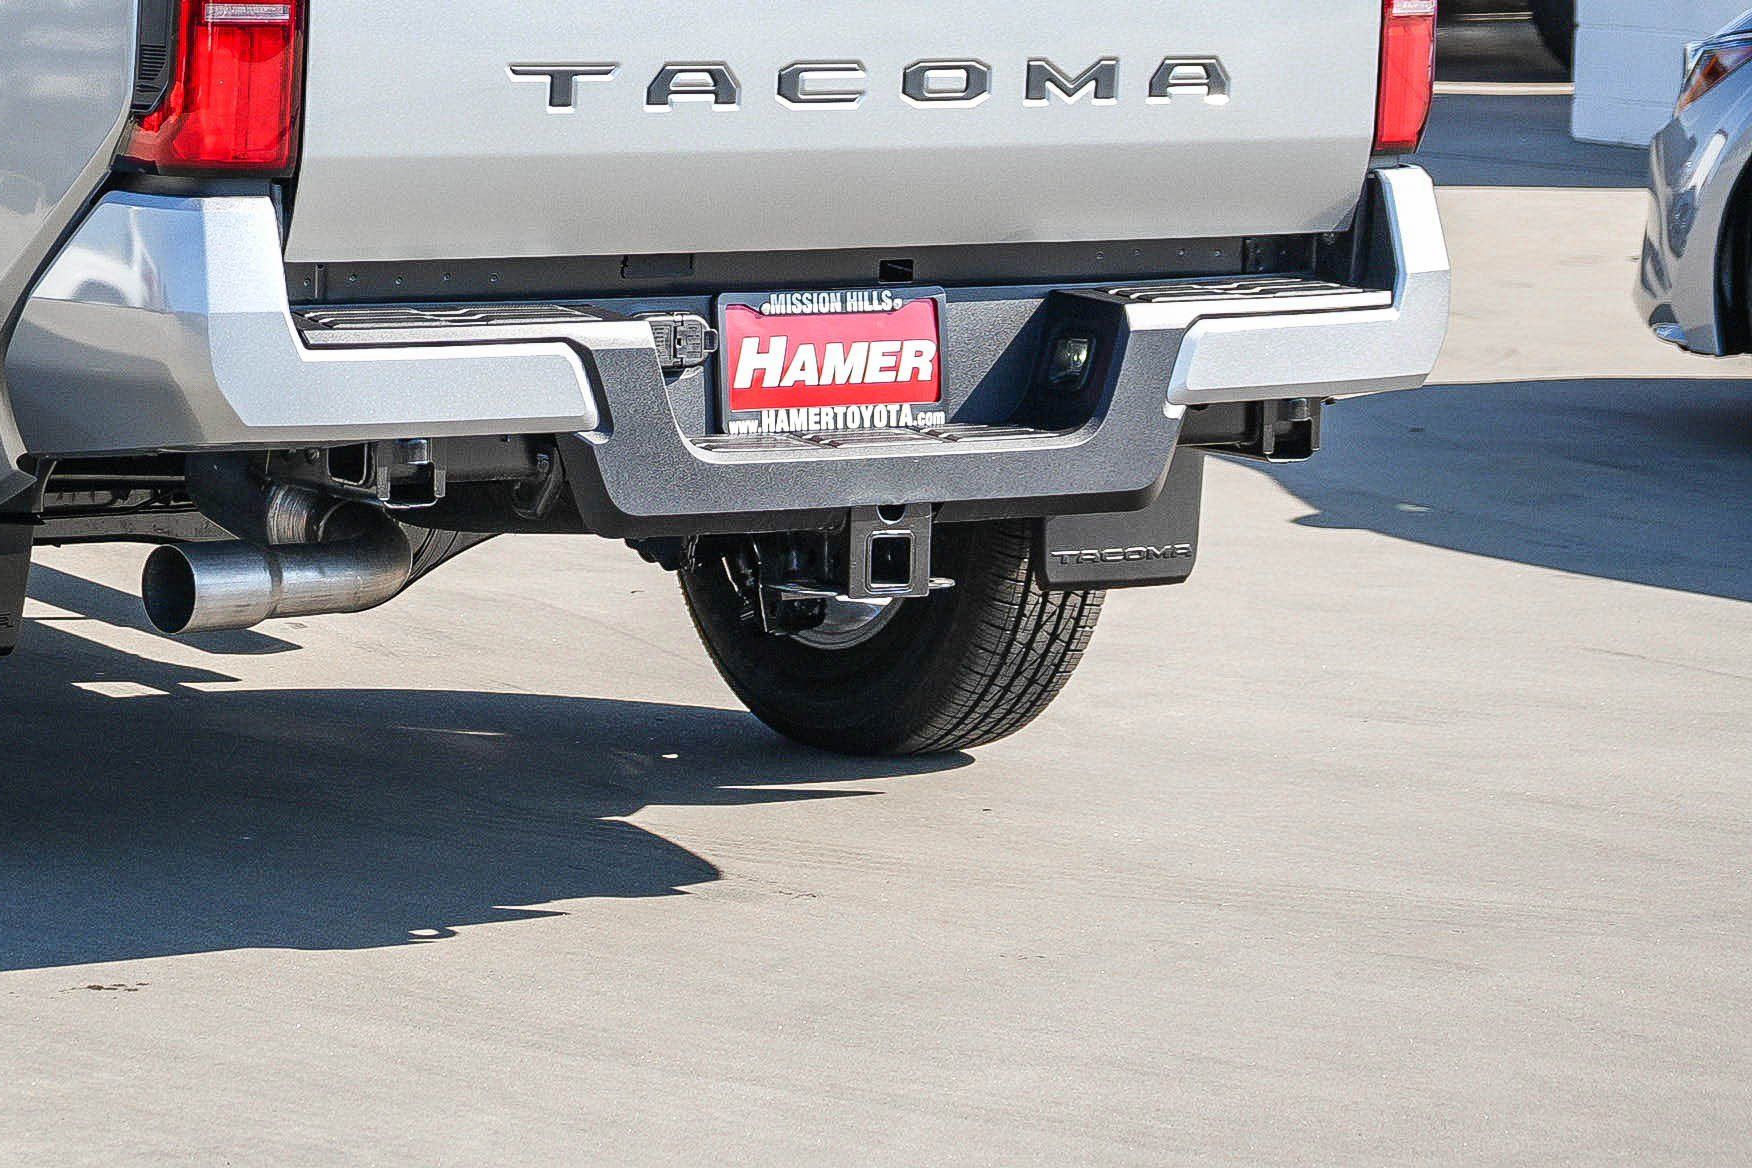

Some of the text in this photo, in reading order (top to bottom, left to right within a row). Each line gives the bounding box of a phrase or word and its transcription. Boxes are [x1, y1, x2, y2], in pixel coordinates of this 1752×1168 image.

[506, 56, 1232, 113] TACOMA
[769, 290, 893, 314] MISSION HILLS
[733, 335, 938, 389] HAMER
[728, 403, 946, 435] www.HAMERTOYOTA.com
[1050, 543, 1193, 565] TACOMA
